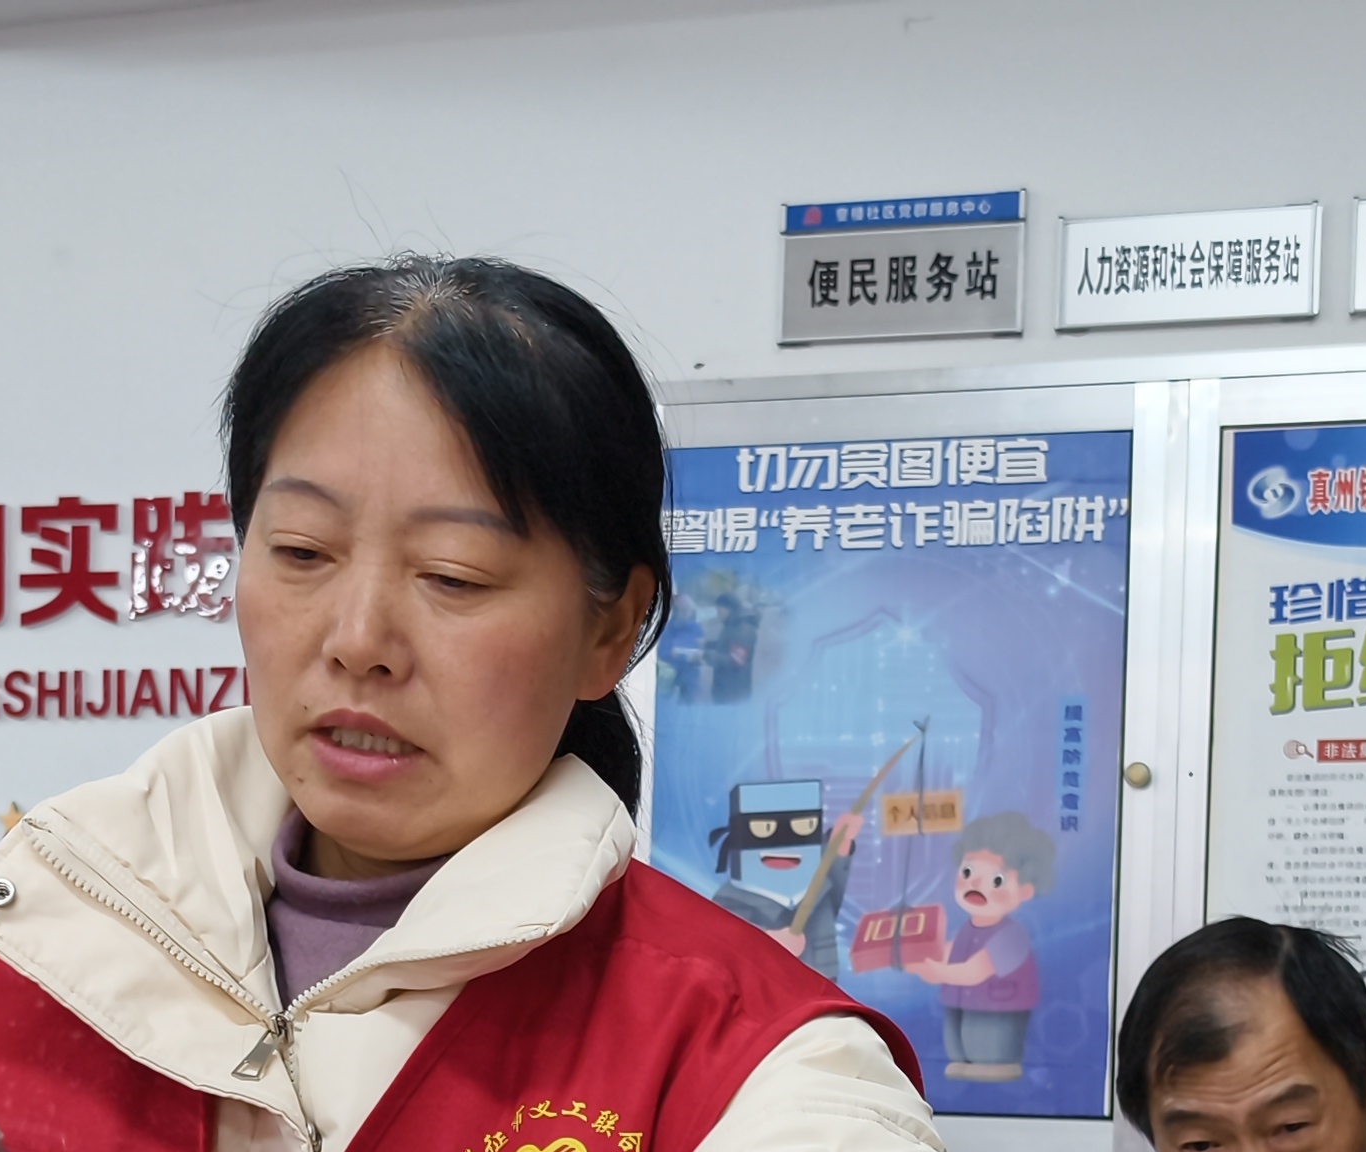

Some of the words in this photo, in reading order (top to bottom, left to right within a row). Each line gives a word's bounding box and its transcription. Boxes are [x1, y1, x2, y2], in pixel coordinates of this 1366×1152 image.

[807, 249, 1000, 308] 便民服务站
[1077, 234, 1301, 296] 人力资源和社会保障服务站
[736, 437, 1050, 494] 切勿贪图便宜
[863, 912, 926, 943] 100
